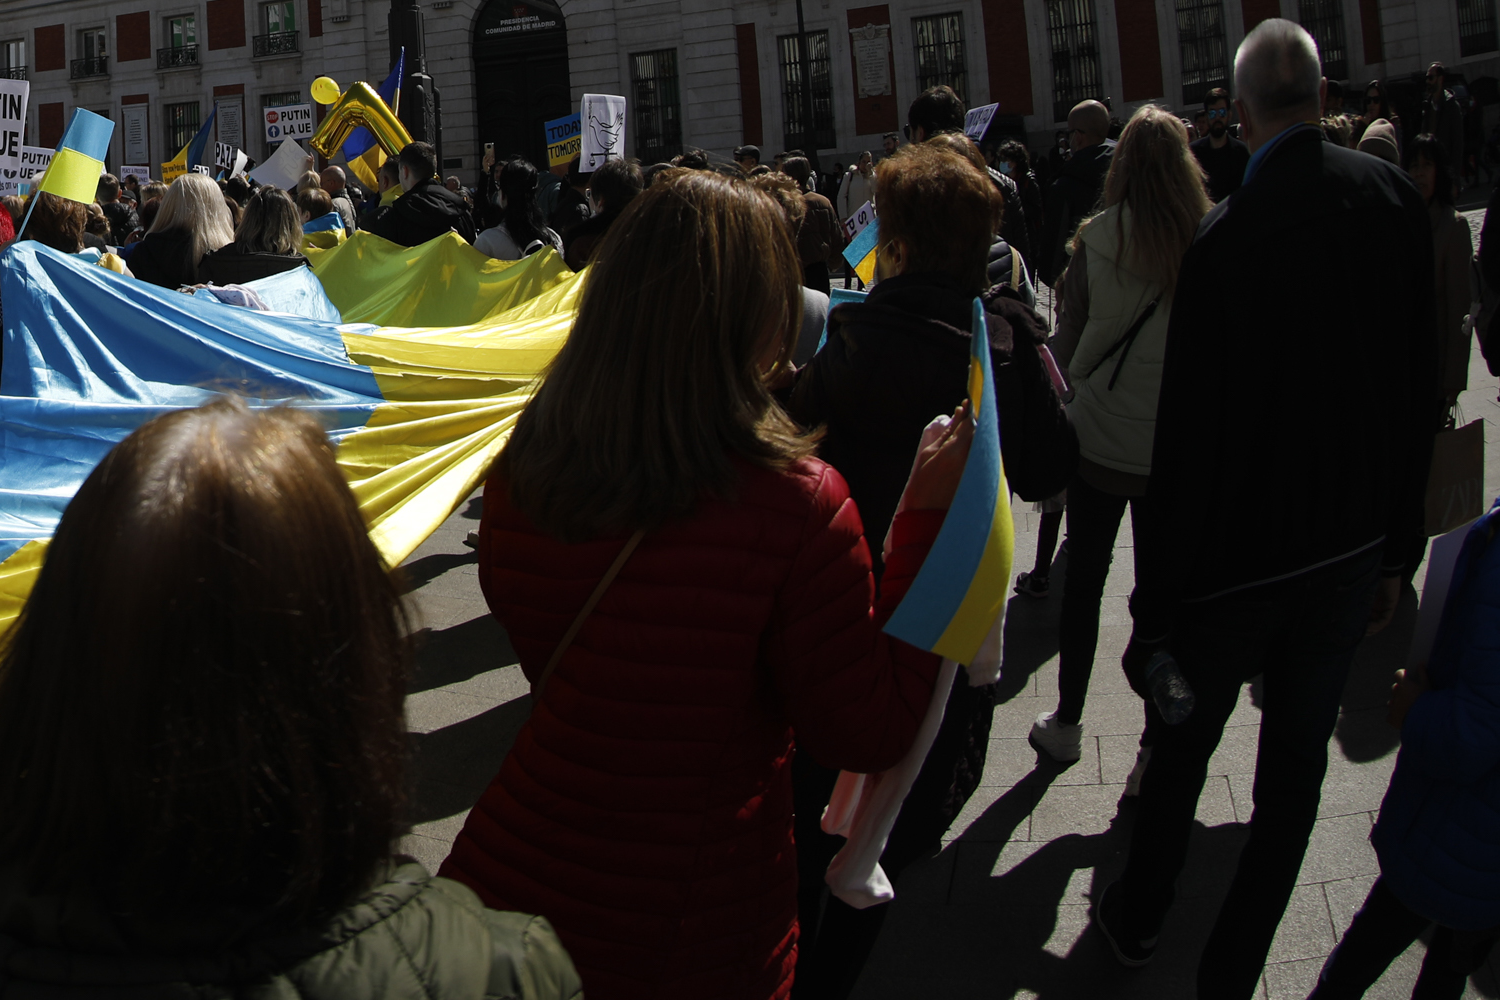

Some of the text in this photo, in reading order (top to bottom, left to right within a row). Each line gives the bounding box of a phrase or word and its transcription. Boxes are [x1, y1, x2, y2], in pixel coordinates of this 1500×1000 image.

[500, 15, 539, 26] PRESIDENCIA
[485, 25, 521, 35] COMUNIDAD
[531, 20, 556, 29] MADRID
[281, 108, 310, 121] PUTIN
[283, 123, 311, 135] LA UE
[21, 152, 53, 166] PUTIN
[216, 141, 232, 170] PAZ
